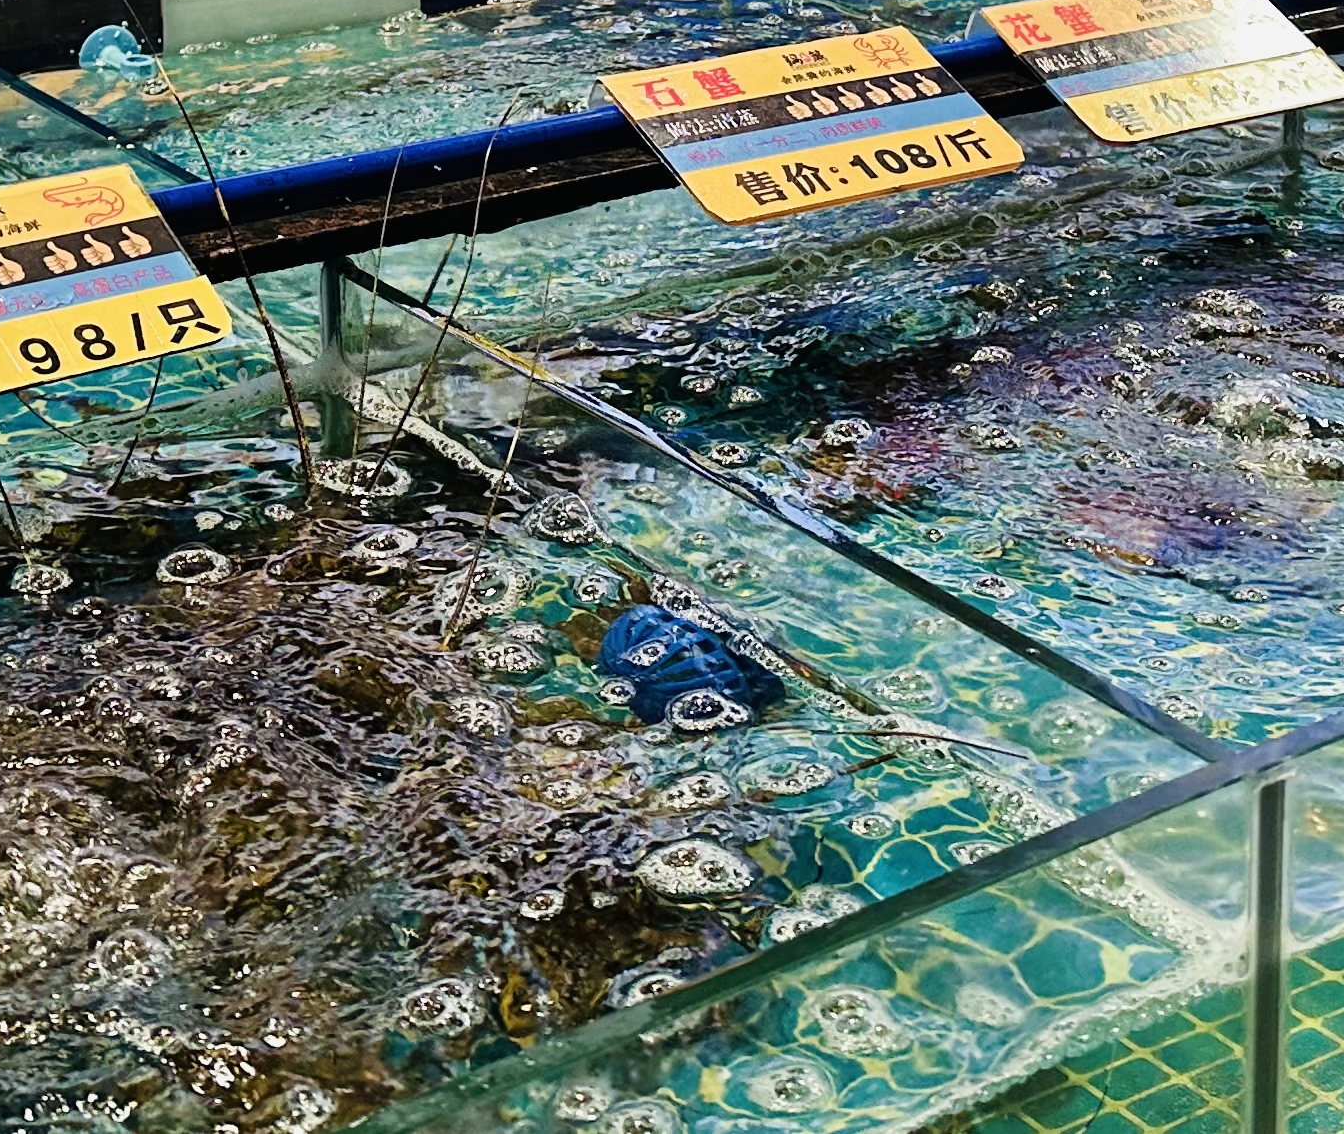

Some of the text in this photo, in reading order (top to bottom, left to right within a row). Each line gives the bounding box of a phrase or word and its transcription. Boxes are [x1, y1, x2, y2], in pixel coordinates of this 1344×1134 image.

[999, 1, 1106, 47] 花蟹
[631, 66, 748, 112] 石蟹
[735, 129, 993, 207] 售价:108/斤
[19, 297, 222, 376] 98/只
